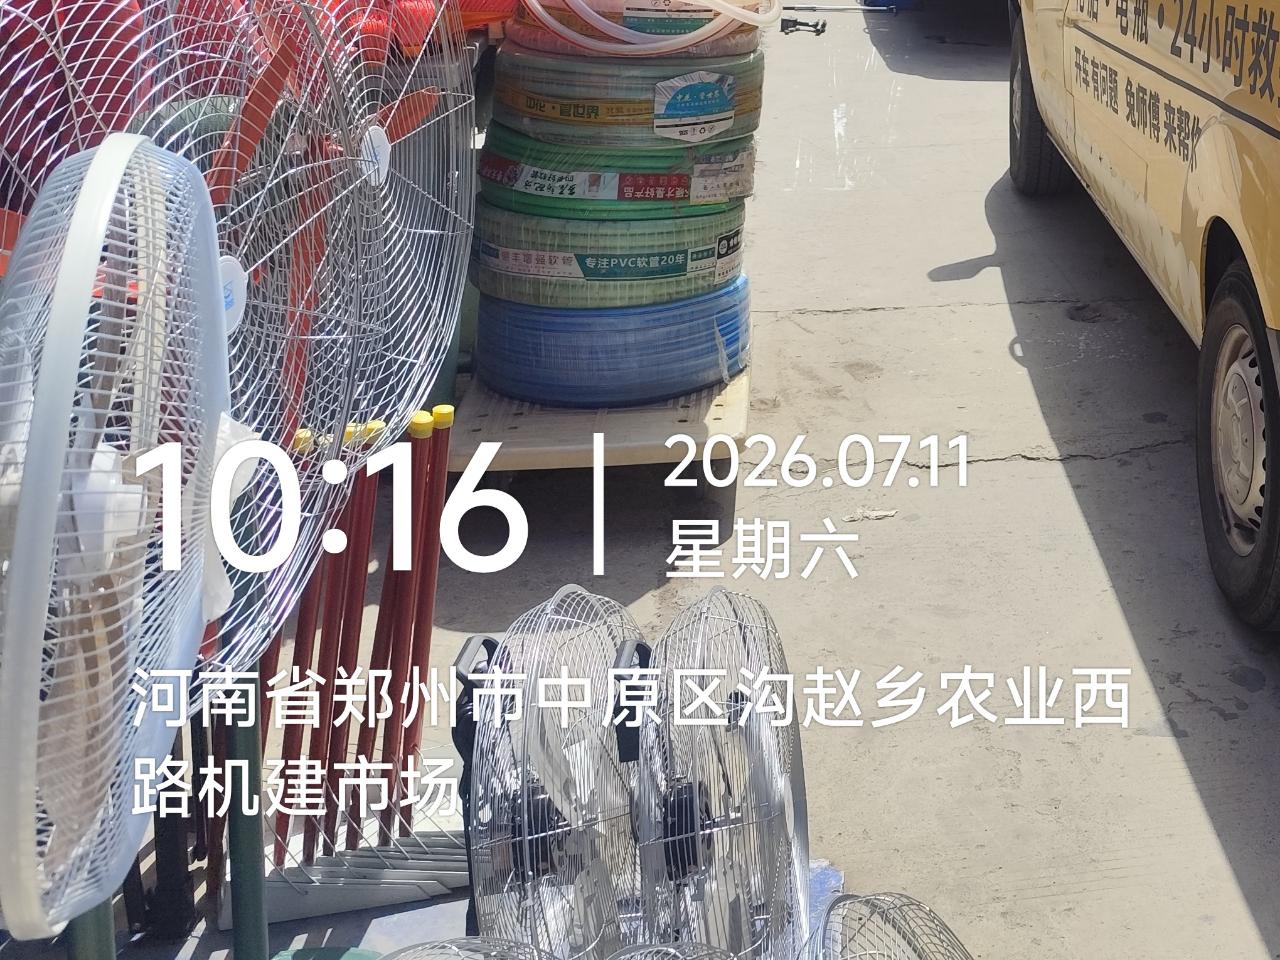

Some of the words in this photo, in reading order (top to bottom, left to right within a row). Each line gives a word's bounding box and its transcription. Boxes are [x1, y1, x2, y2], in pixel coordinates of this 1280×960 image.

[1074, 46, 1119, 115] 开车有问题
[585, 253, 687, 270] 专注PVC软管20年
